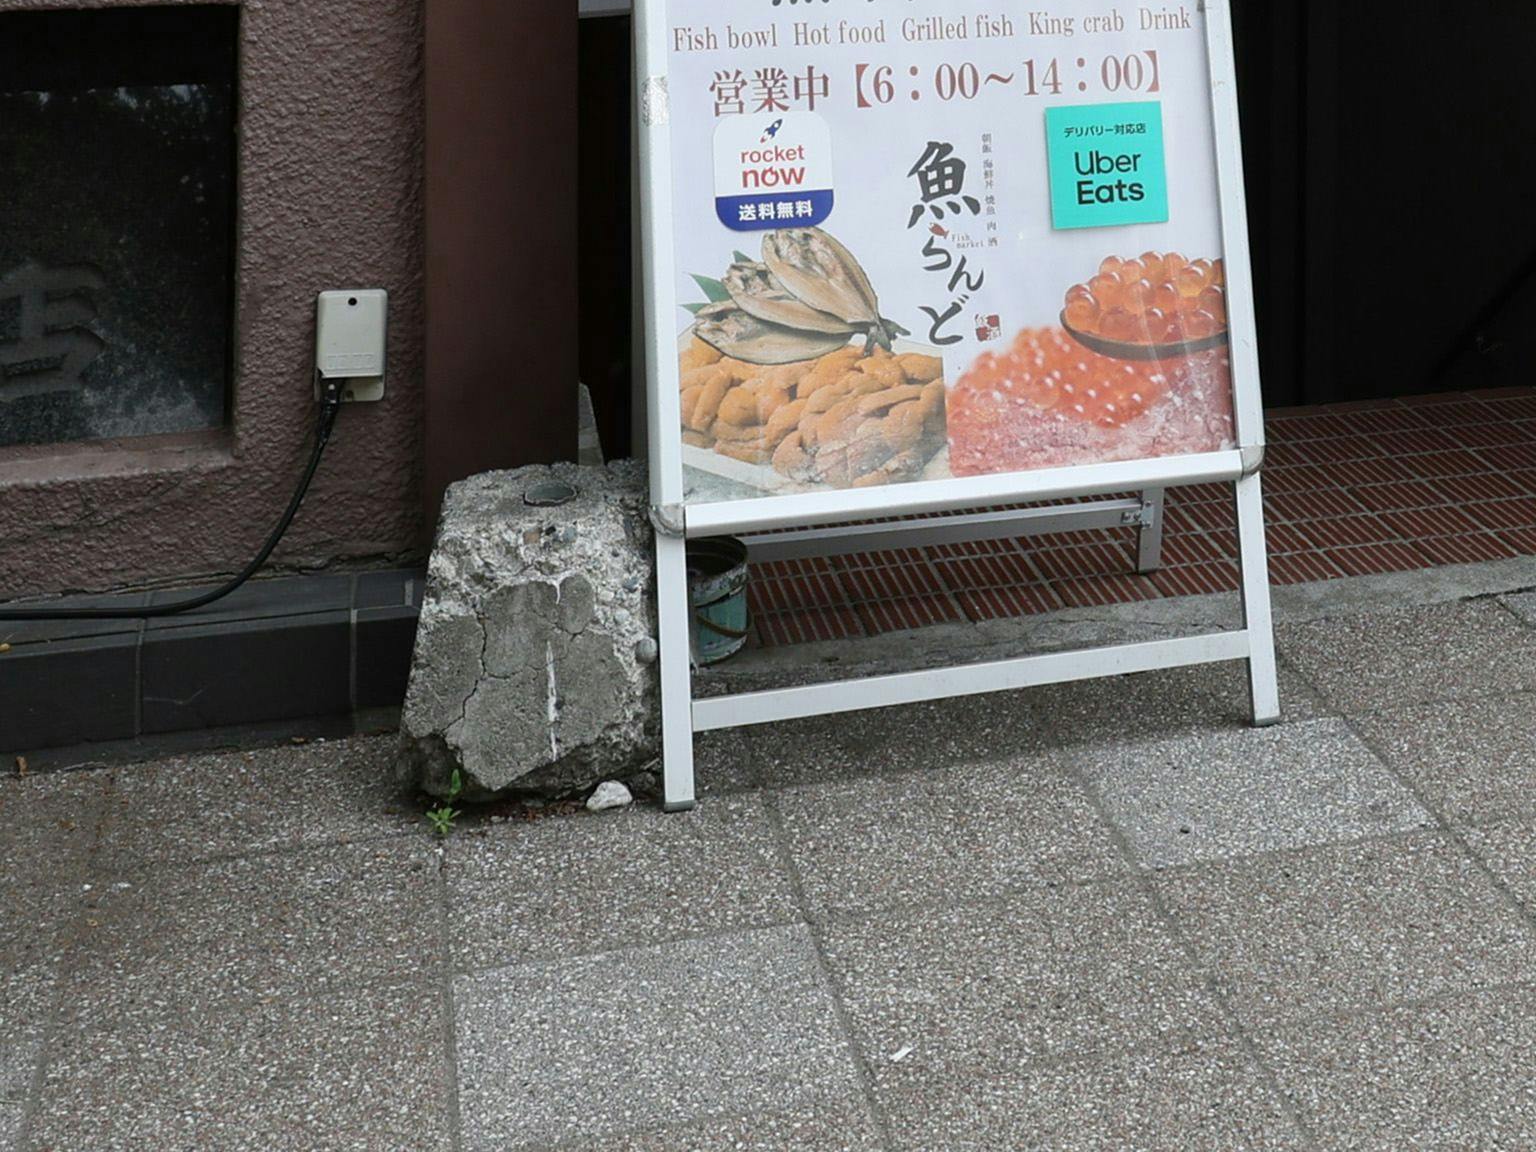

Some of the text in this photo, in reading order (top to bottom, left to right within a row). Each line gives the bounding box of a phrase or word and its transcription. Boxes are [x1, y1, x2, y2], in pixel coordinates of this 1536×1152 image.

[673, 6, 1192, 52] Fish bowl Hot food Grilled fish King crab Drink
[1063, 122, 1148, 139] デリバリー対応店
[741, 144, 805, 163] rocket
[1073, 150, 1142, 176] Uber
[742, 163, 806, 189] now
[1077, 179, 1145, 206] Eats
[737, 198, 815, 222] 送料無料
[907, 141, 984, 346] 魚らんど
